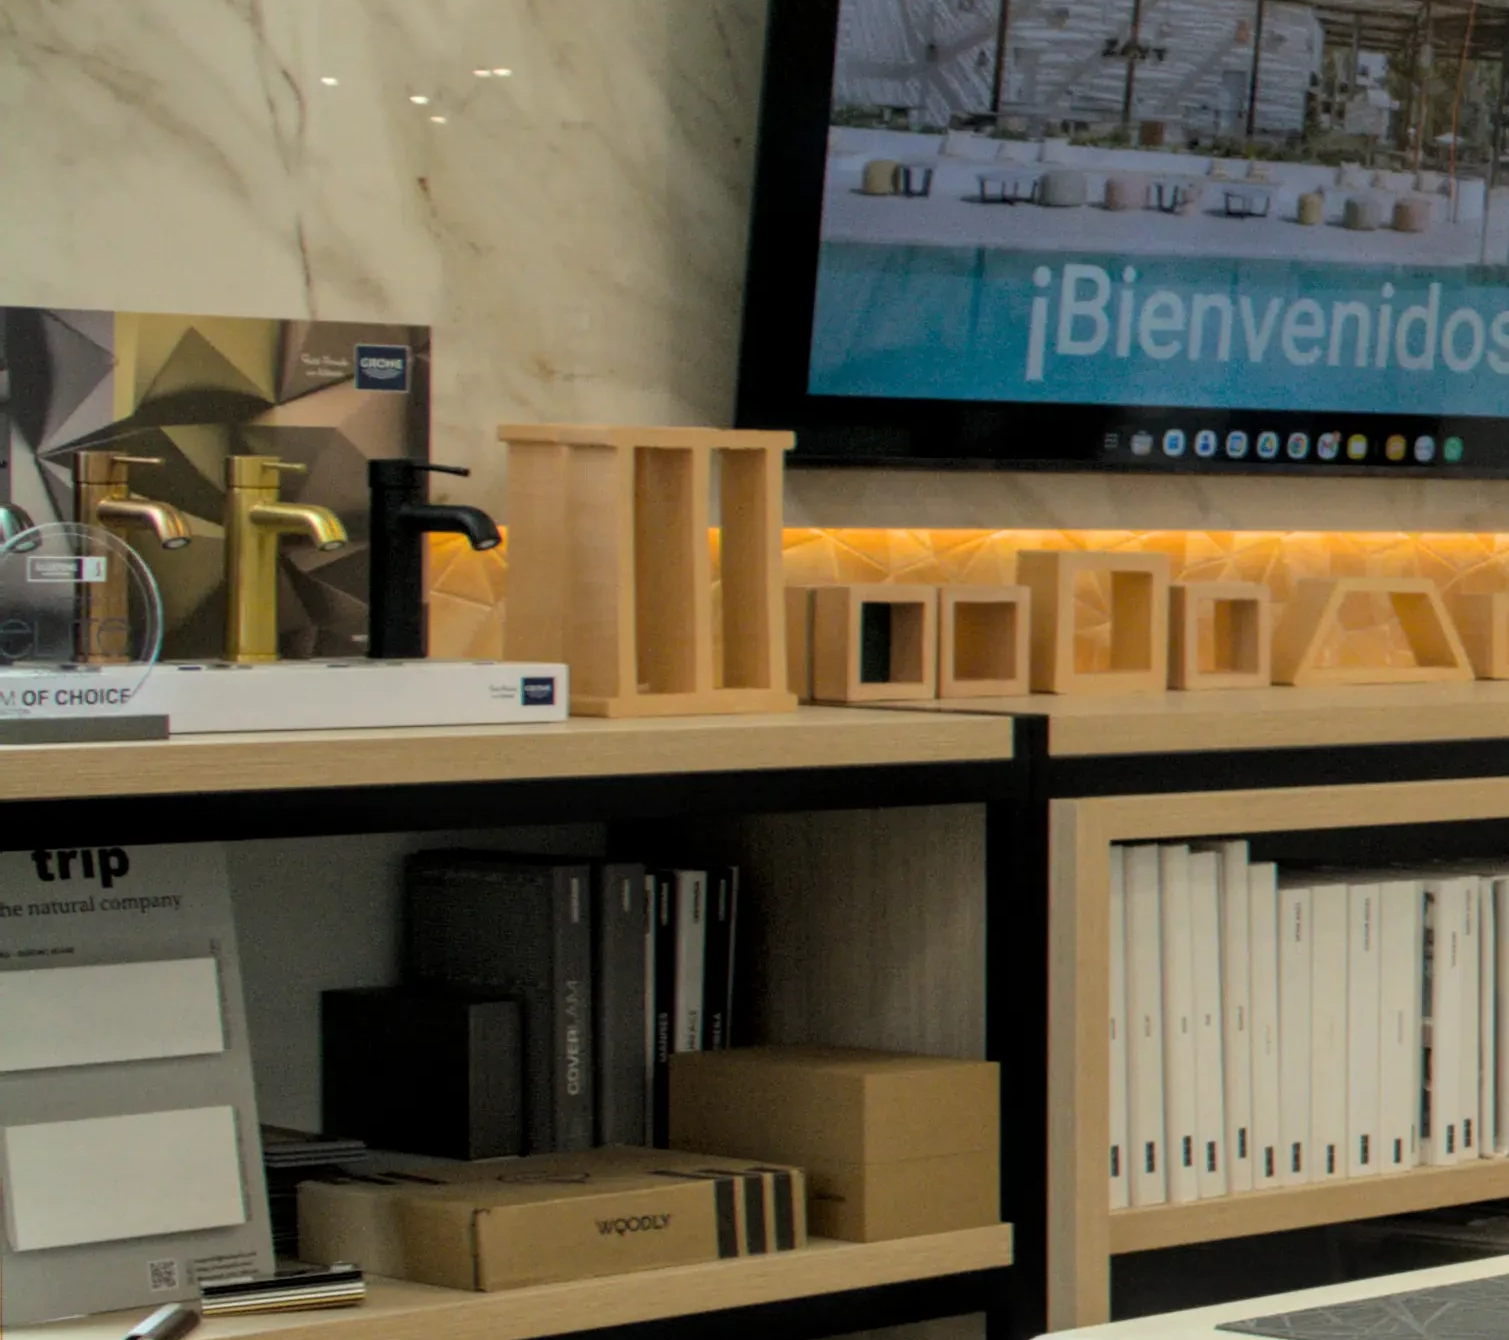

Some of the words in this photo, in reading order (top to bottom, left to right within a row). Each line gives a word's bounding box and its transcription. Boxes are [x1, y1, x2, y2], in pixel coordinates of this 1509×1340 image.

[22, 690, 49, 707] OF
[55, 688, 133, 706] CHOICE
[28, 895, 96, 917] natural
[100, 893, 183, 914] company
